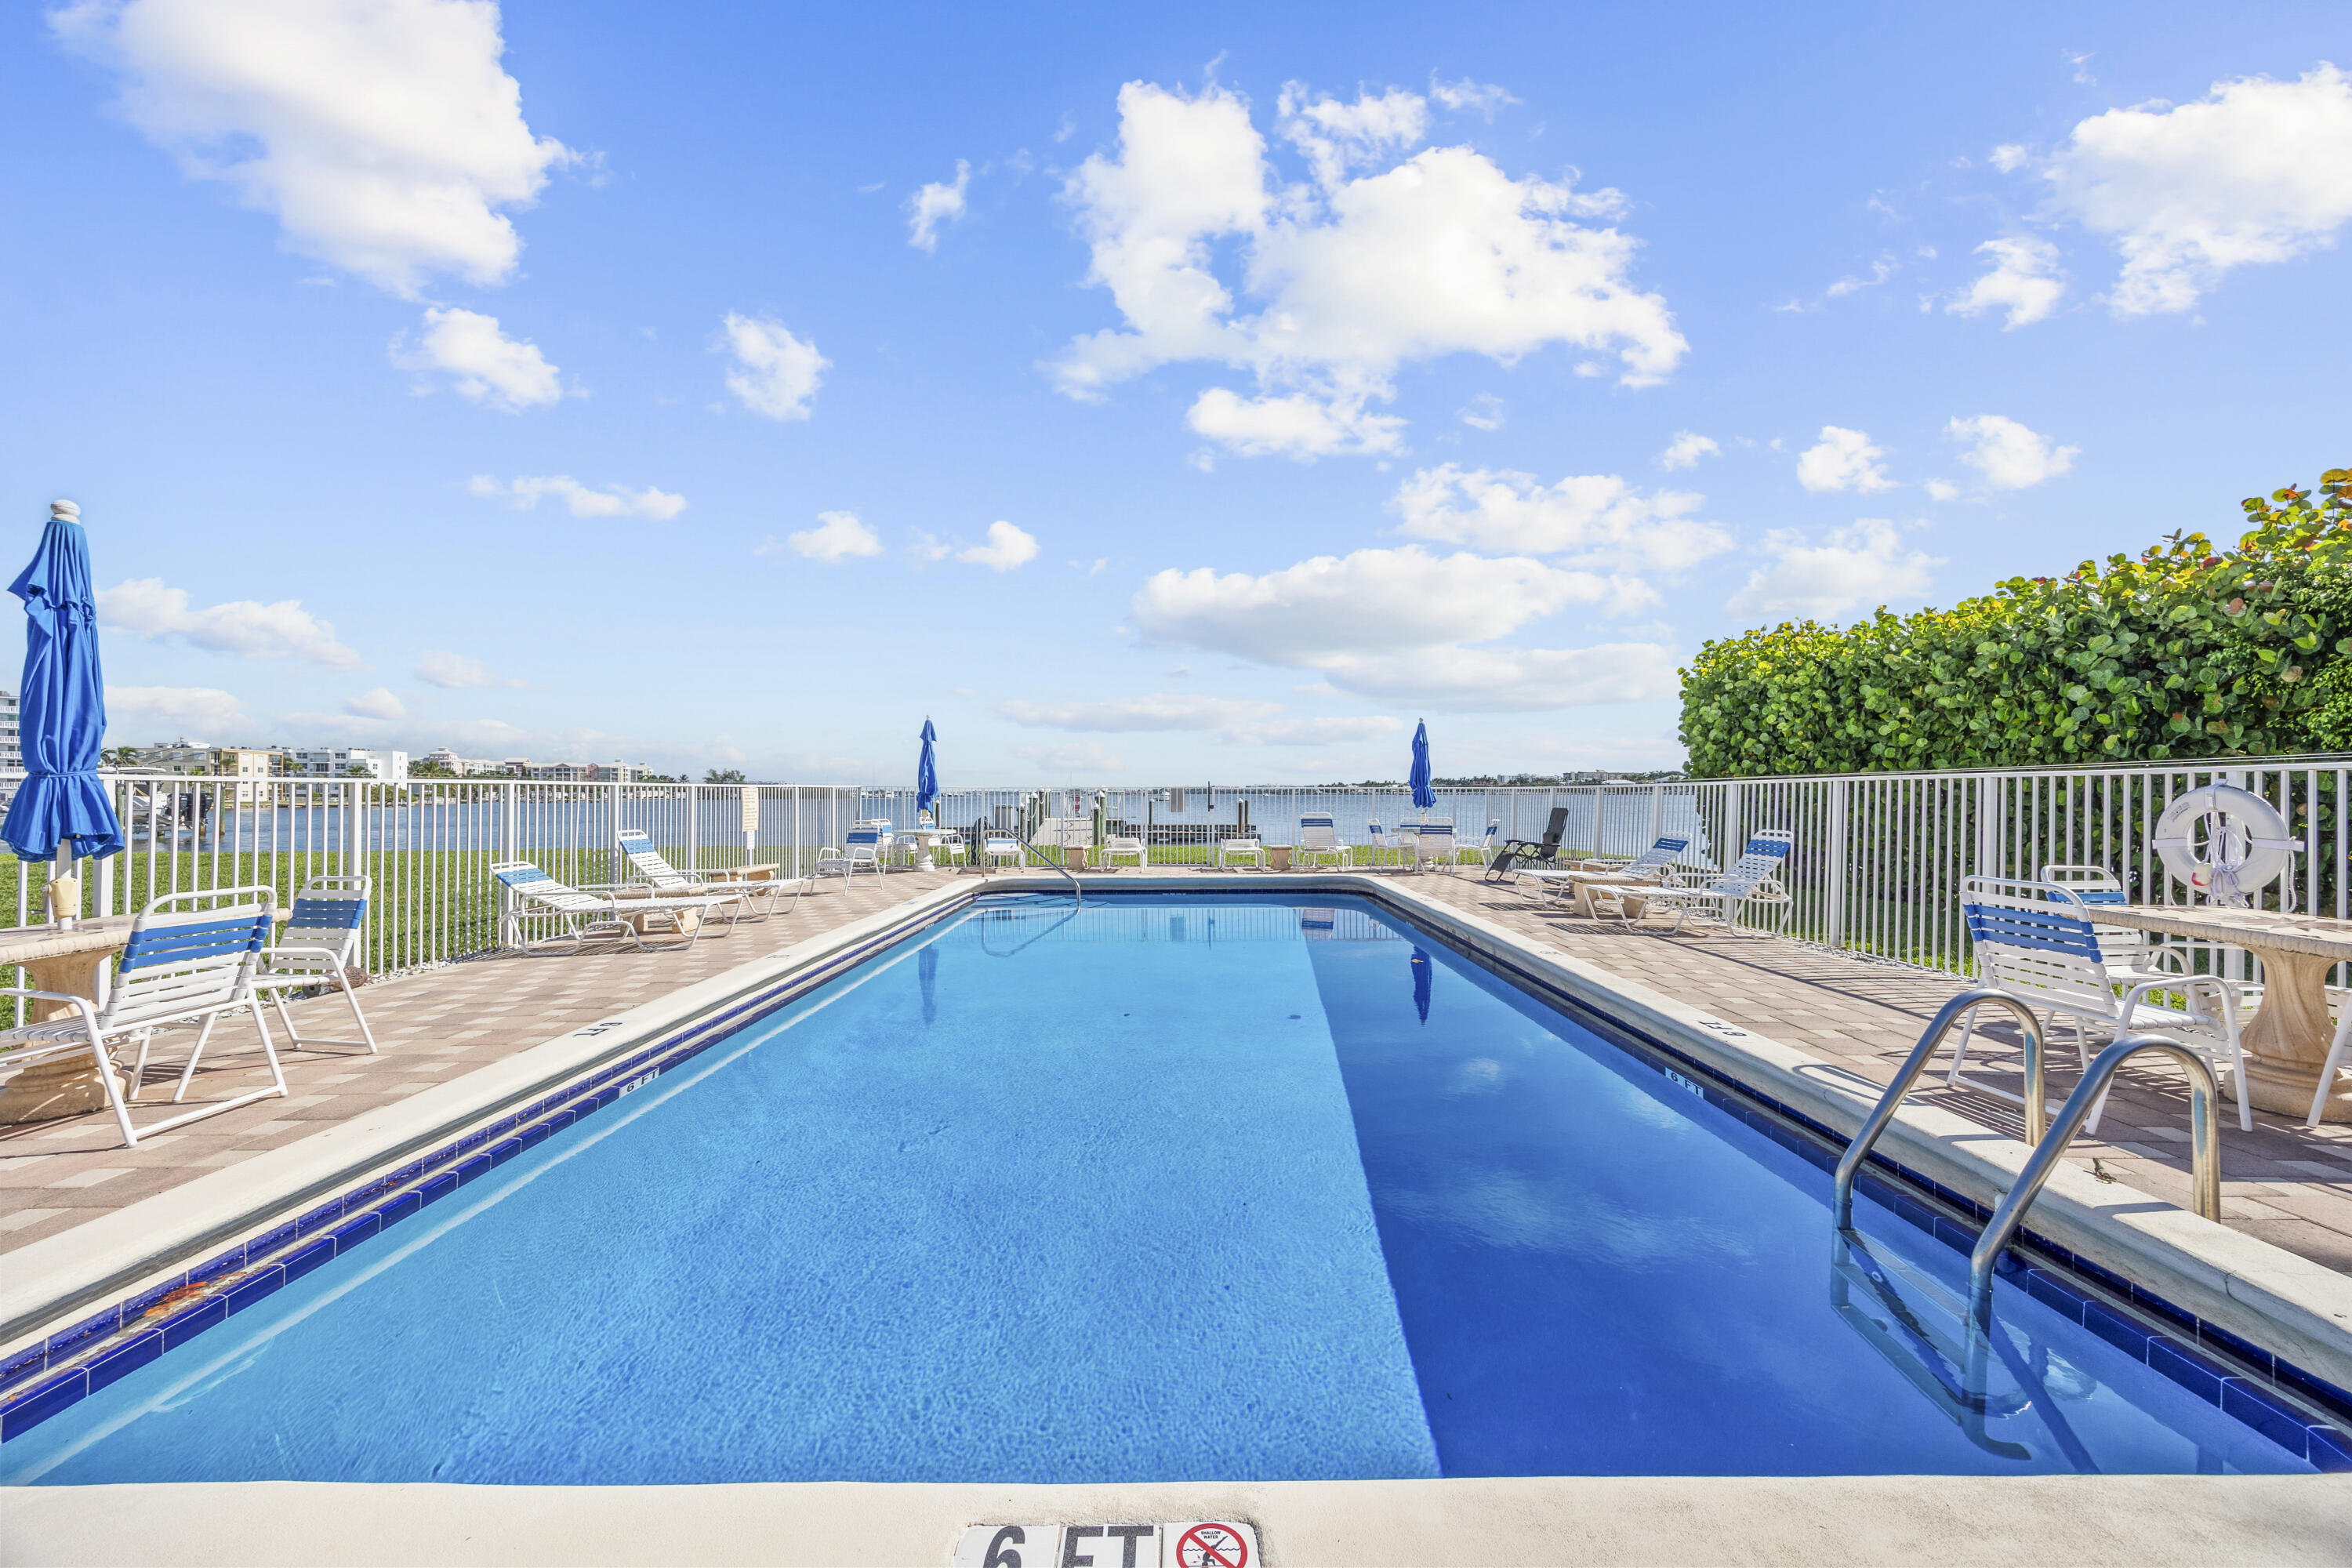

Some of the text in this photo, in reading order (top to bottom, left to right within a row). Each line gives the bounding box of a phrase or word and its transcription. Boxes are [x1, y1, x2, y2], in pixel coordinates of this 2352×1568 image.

[627, 1070, 659, 1092] 6 FT
[1671, 1072, 1702, 1095] 6 FT
[982, 1525, 1154, 1568] 6 FT
